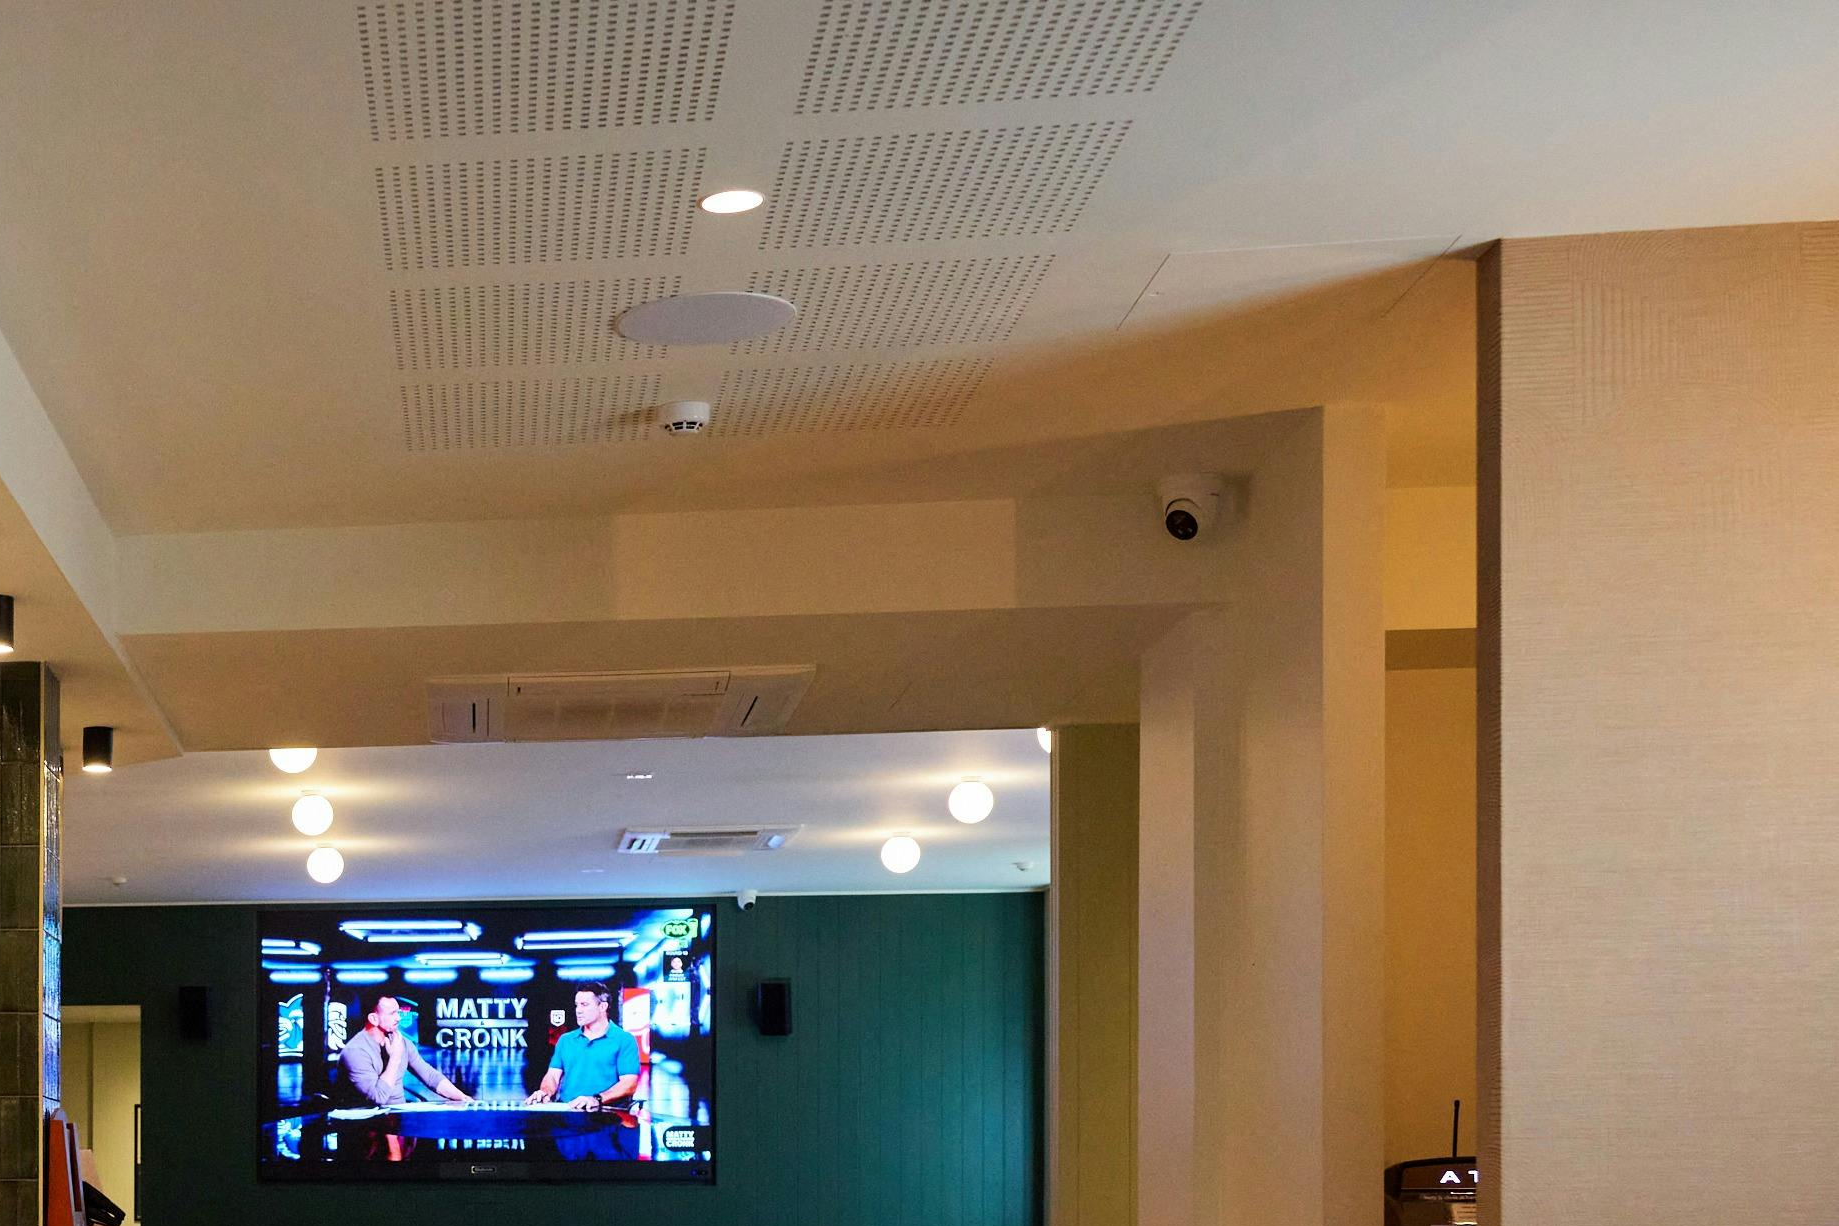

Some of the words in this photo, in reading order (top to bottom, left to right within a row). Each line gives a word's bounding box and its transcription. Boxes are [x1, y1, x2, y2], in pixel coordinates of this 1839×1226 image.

[665, 923, 689, 936] FOX
[436, 997, 528, 1019] MATTY
[436, 1028, 528, 1049] CRONK
